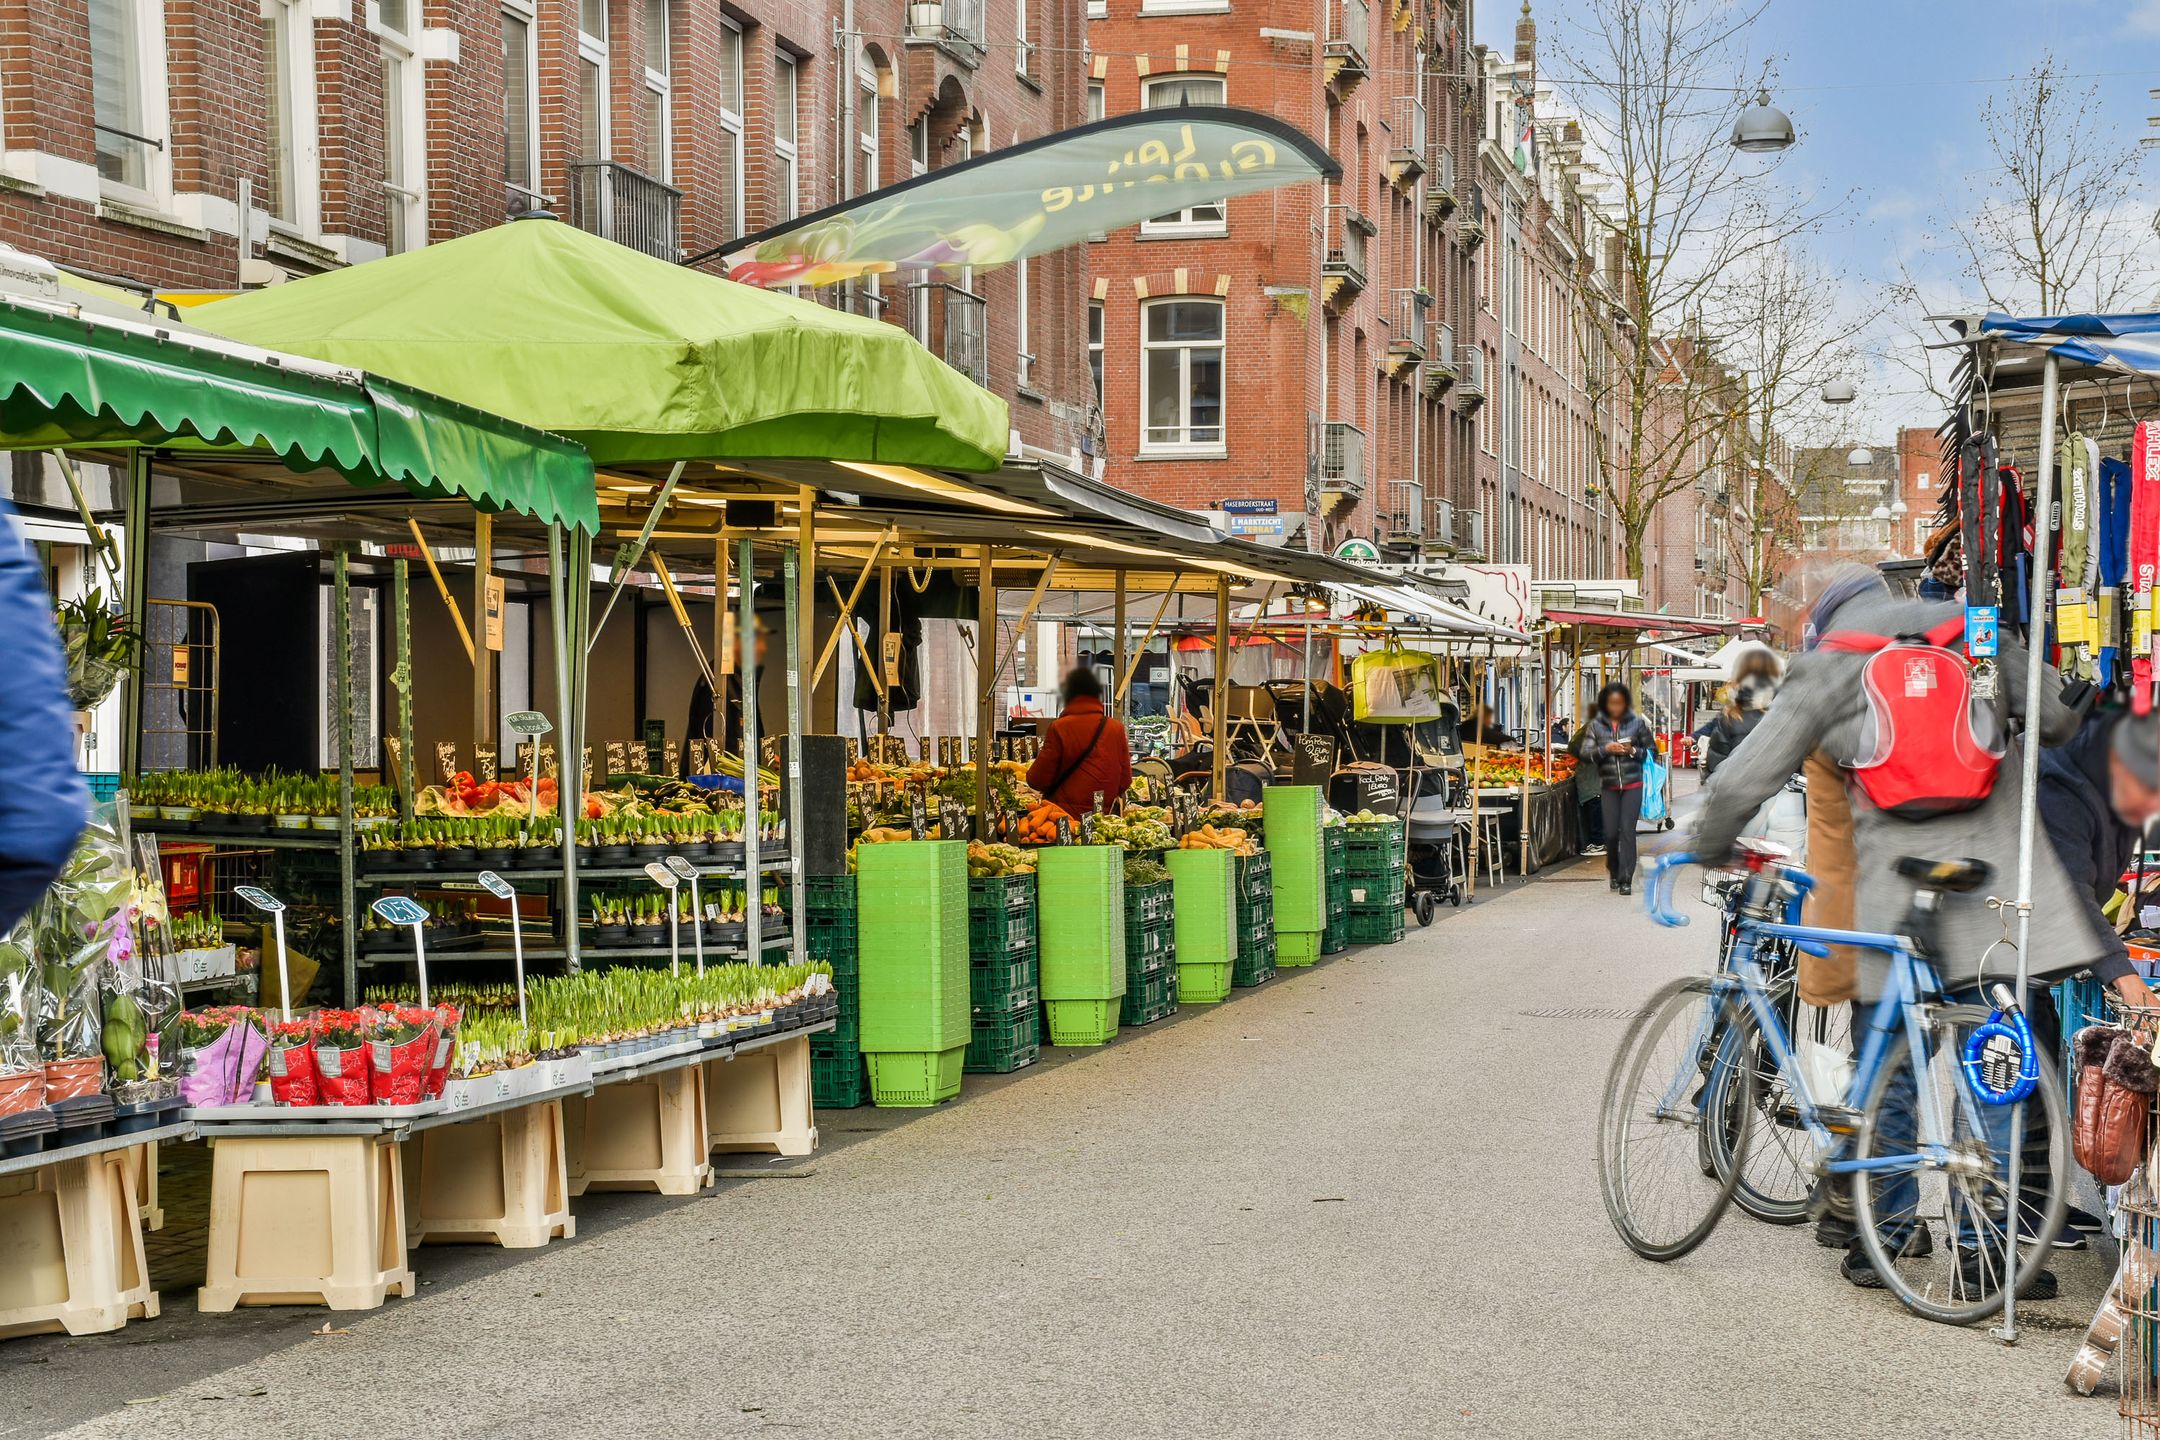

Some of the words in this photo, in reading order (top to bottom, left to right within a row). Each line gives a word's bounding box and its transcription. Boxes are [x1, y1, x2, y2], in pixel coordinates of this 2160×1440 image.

[2072, 467, 2086, 531] STAHLEX
[1238, 518, 1282, 526] MARKTZICHT
[2050, 504, 2060, 528] ABUS
[1244, 527, 1275, 535] TERRAS
